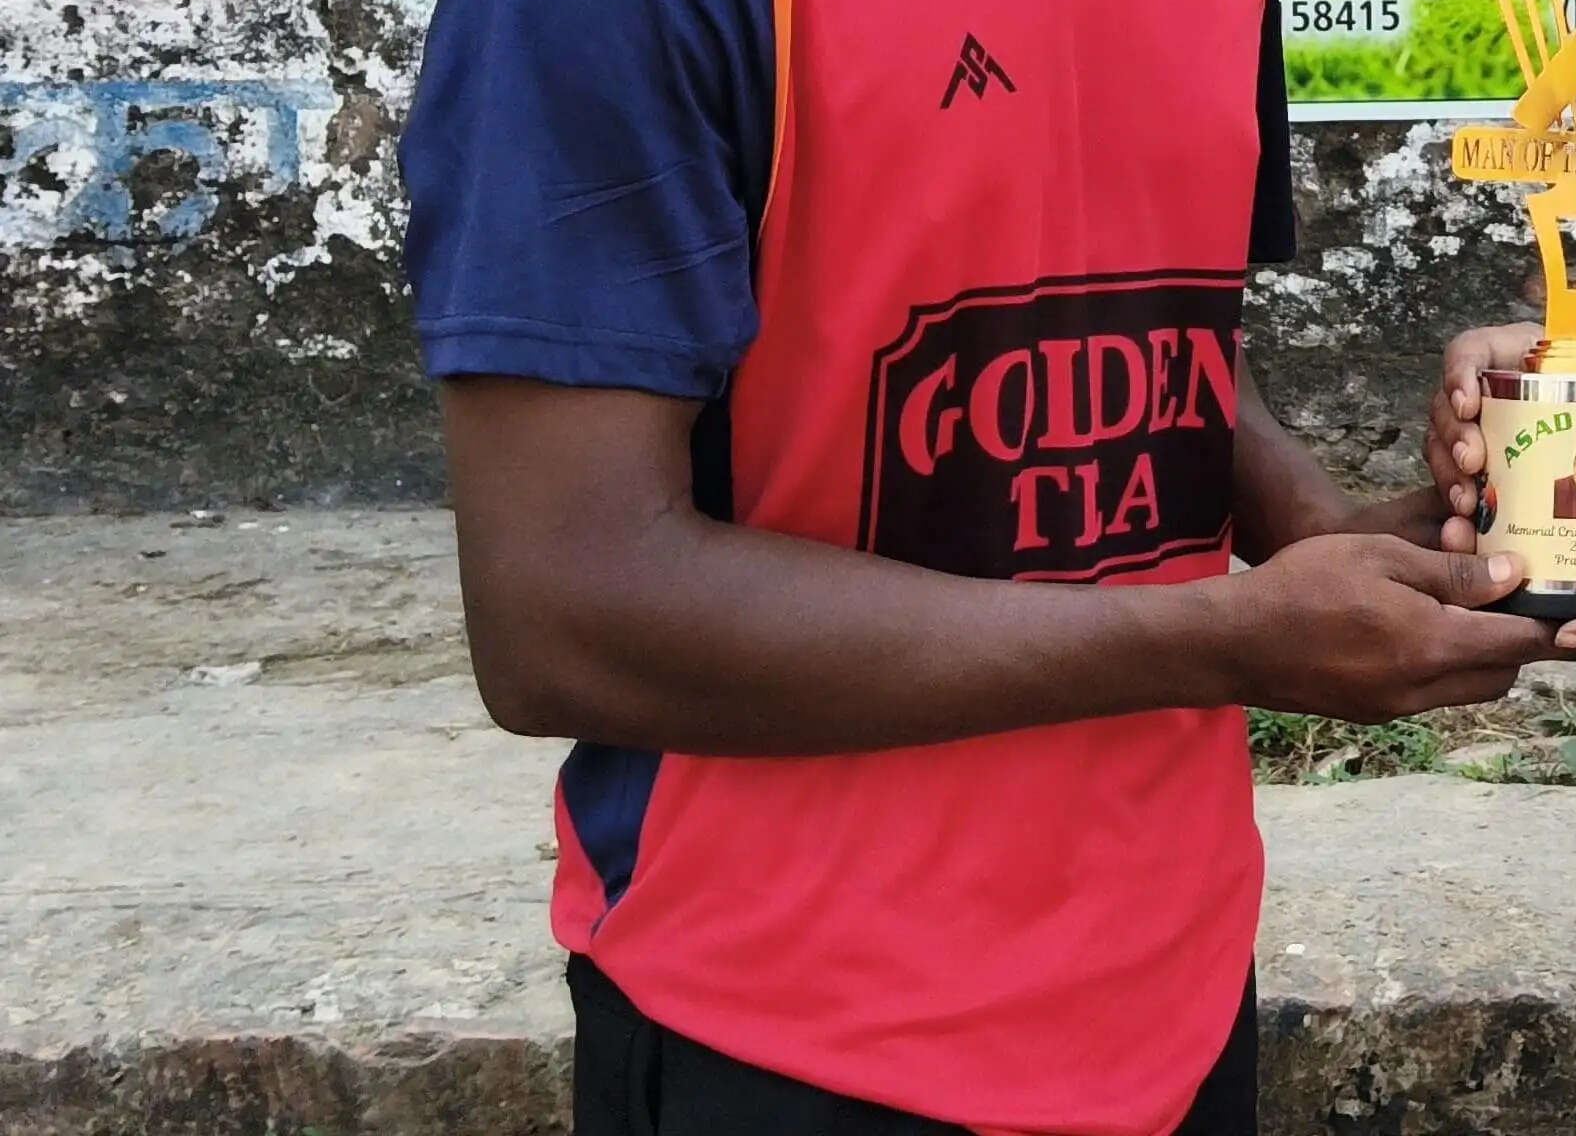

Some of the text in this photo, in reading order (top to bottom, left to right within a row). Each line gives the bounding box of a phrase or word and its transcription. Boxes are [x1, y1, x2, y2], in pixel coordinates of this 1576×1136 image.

[1291, 0, 1400, 32] 58415
[1462, 137, 1513, 170] MAN
[1523, 140, 1554, 172] OF
[1504, 411, 1573, 470] ASAD
[1505, 523, 1556, 538] Memorial
